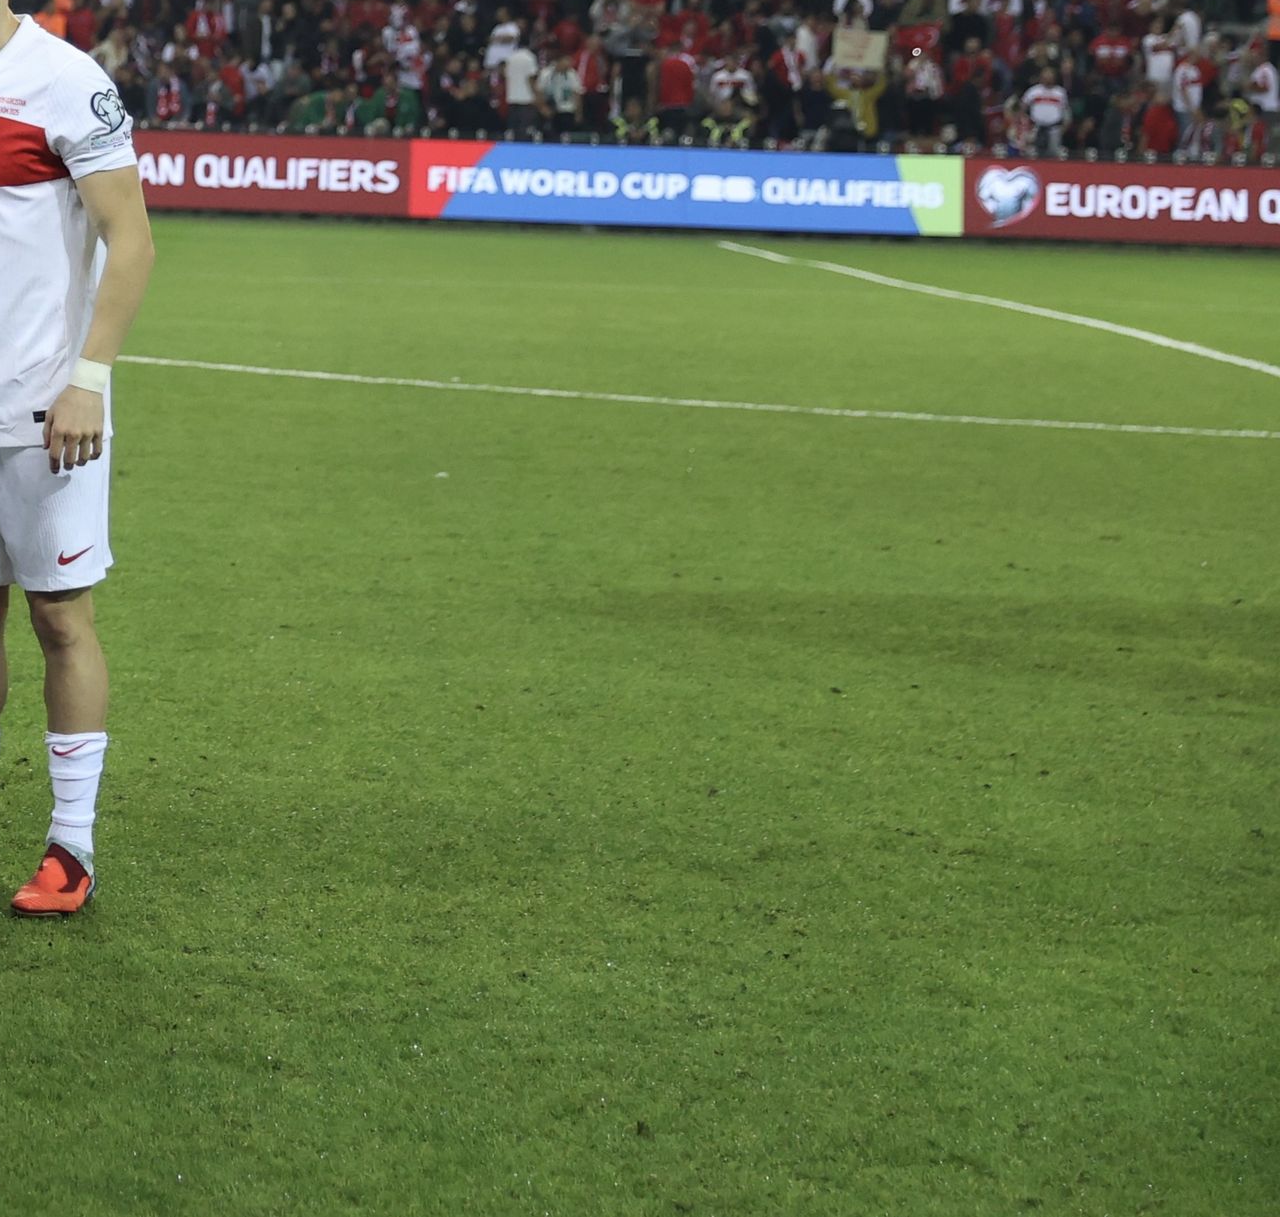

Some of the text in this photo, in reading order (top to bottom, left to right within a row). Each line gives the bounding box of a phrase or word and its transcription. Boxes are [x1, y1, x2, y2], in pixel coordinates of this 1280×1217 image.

[194, 153, 400, 195] QUALIFIERS
[427, 165, 498, 195] FIFA
[499, 168, 617, 199] WORLD
[621, 172, 689, 201] CUP
[762, 177, 944, 209] QUALIFIERS
[1045, 183, 1249, 223] EUROPEAN
